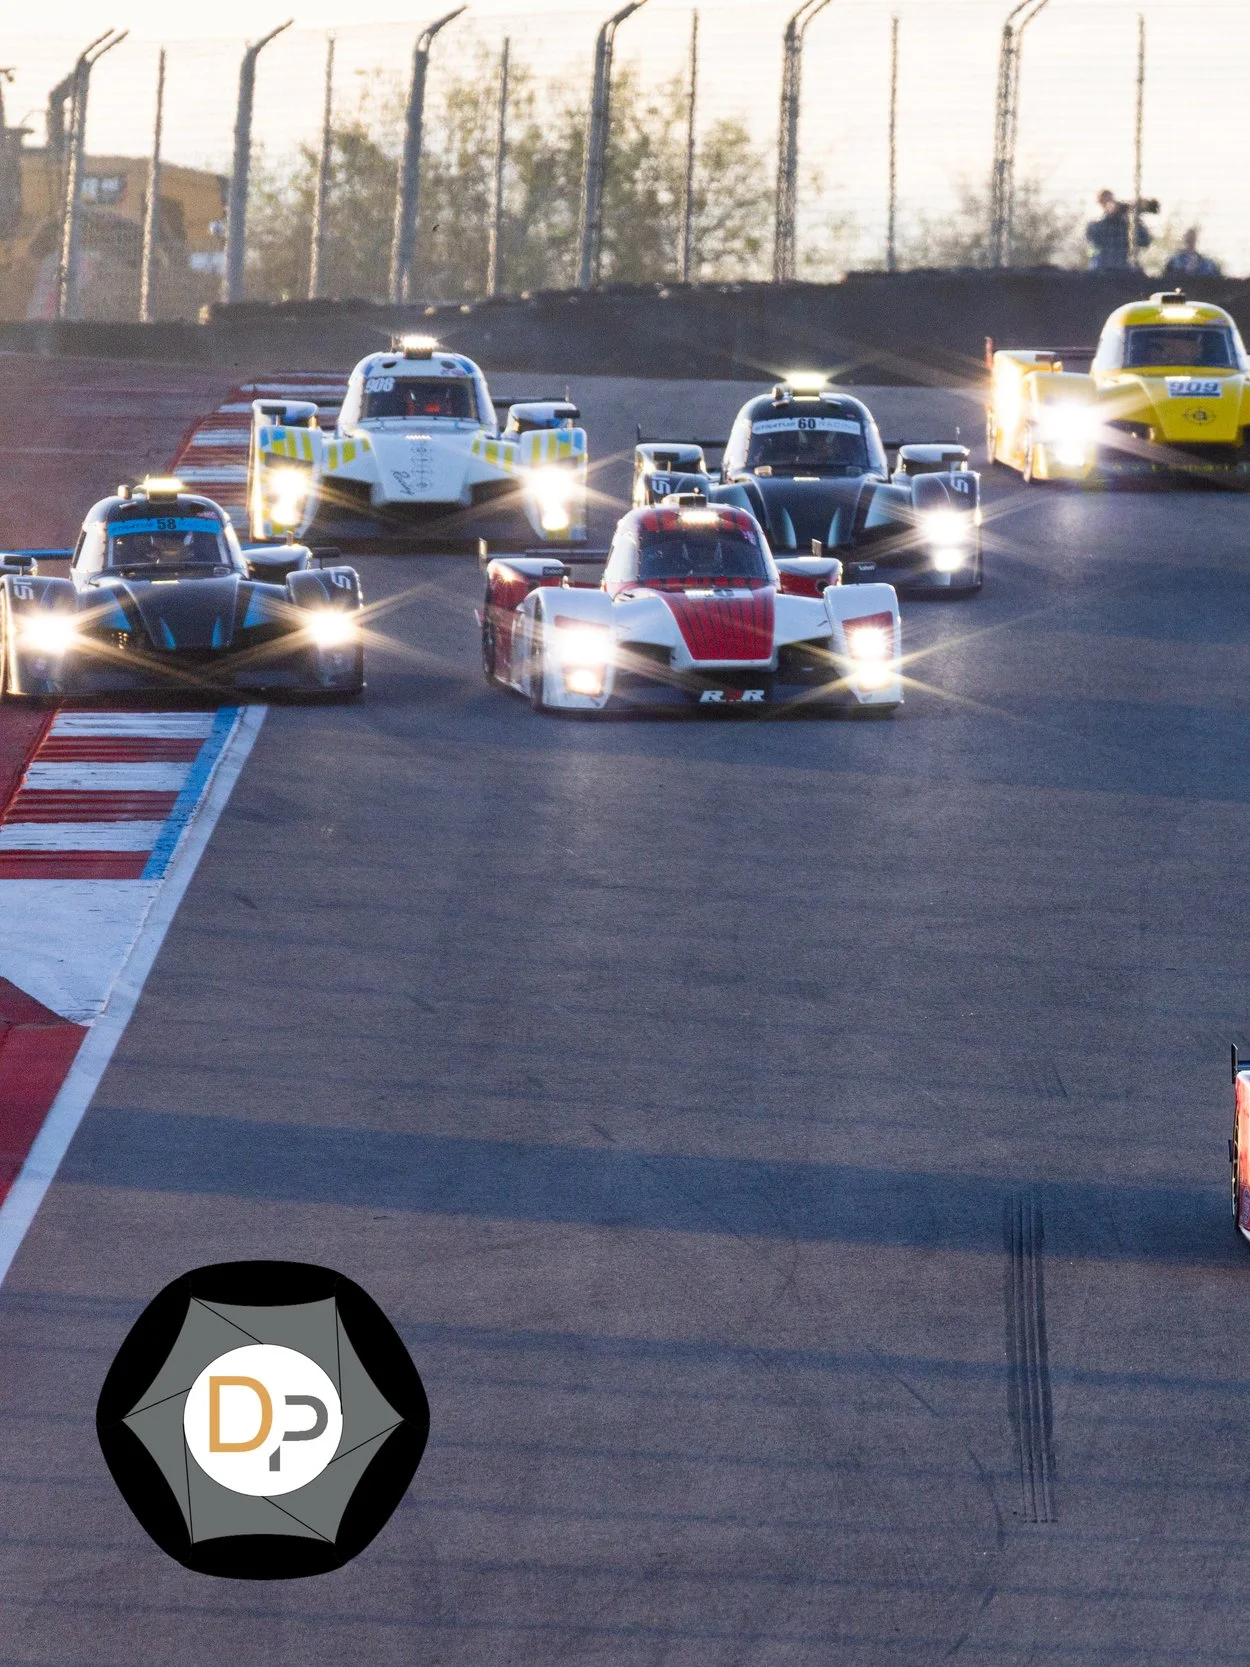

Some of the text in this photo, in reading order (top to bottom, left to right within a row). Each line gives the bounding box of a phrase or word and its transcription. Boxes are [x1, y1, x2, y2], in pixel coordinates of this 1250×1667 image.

[365, 377, 395, 393] 908
[1168, 381, 1219, 393] 909
[797, 418, 817, 430] 60
[156, 518, 177, 530] 58
